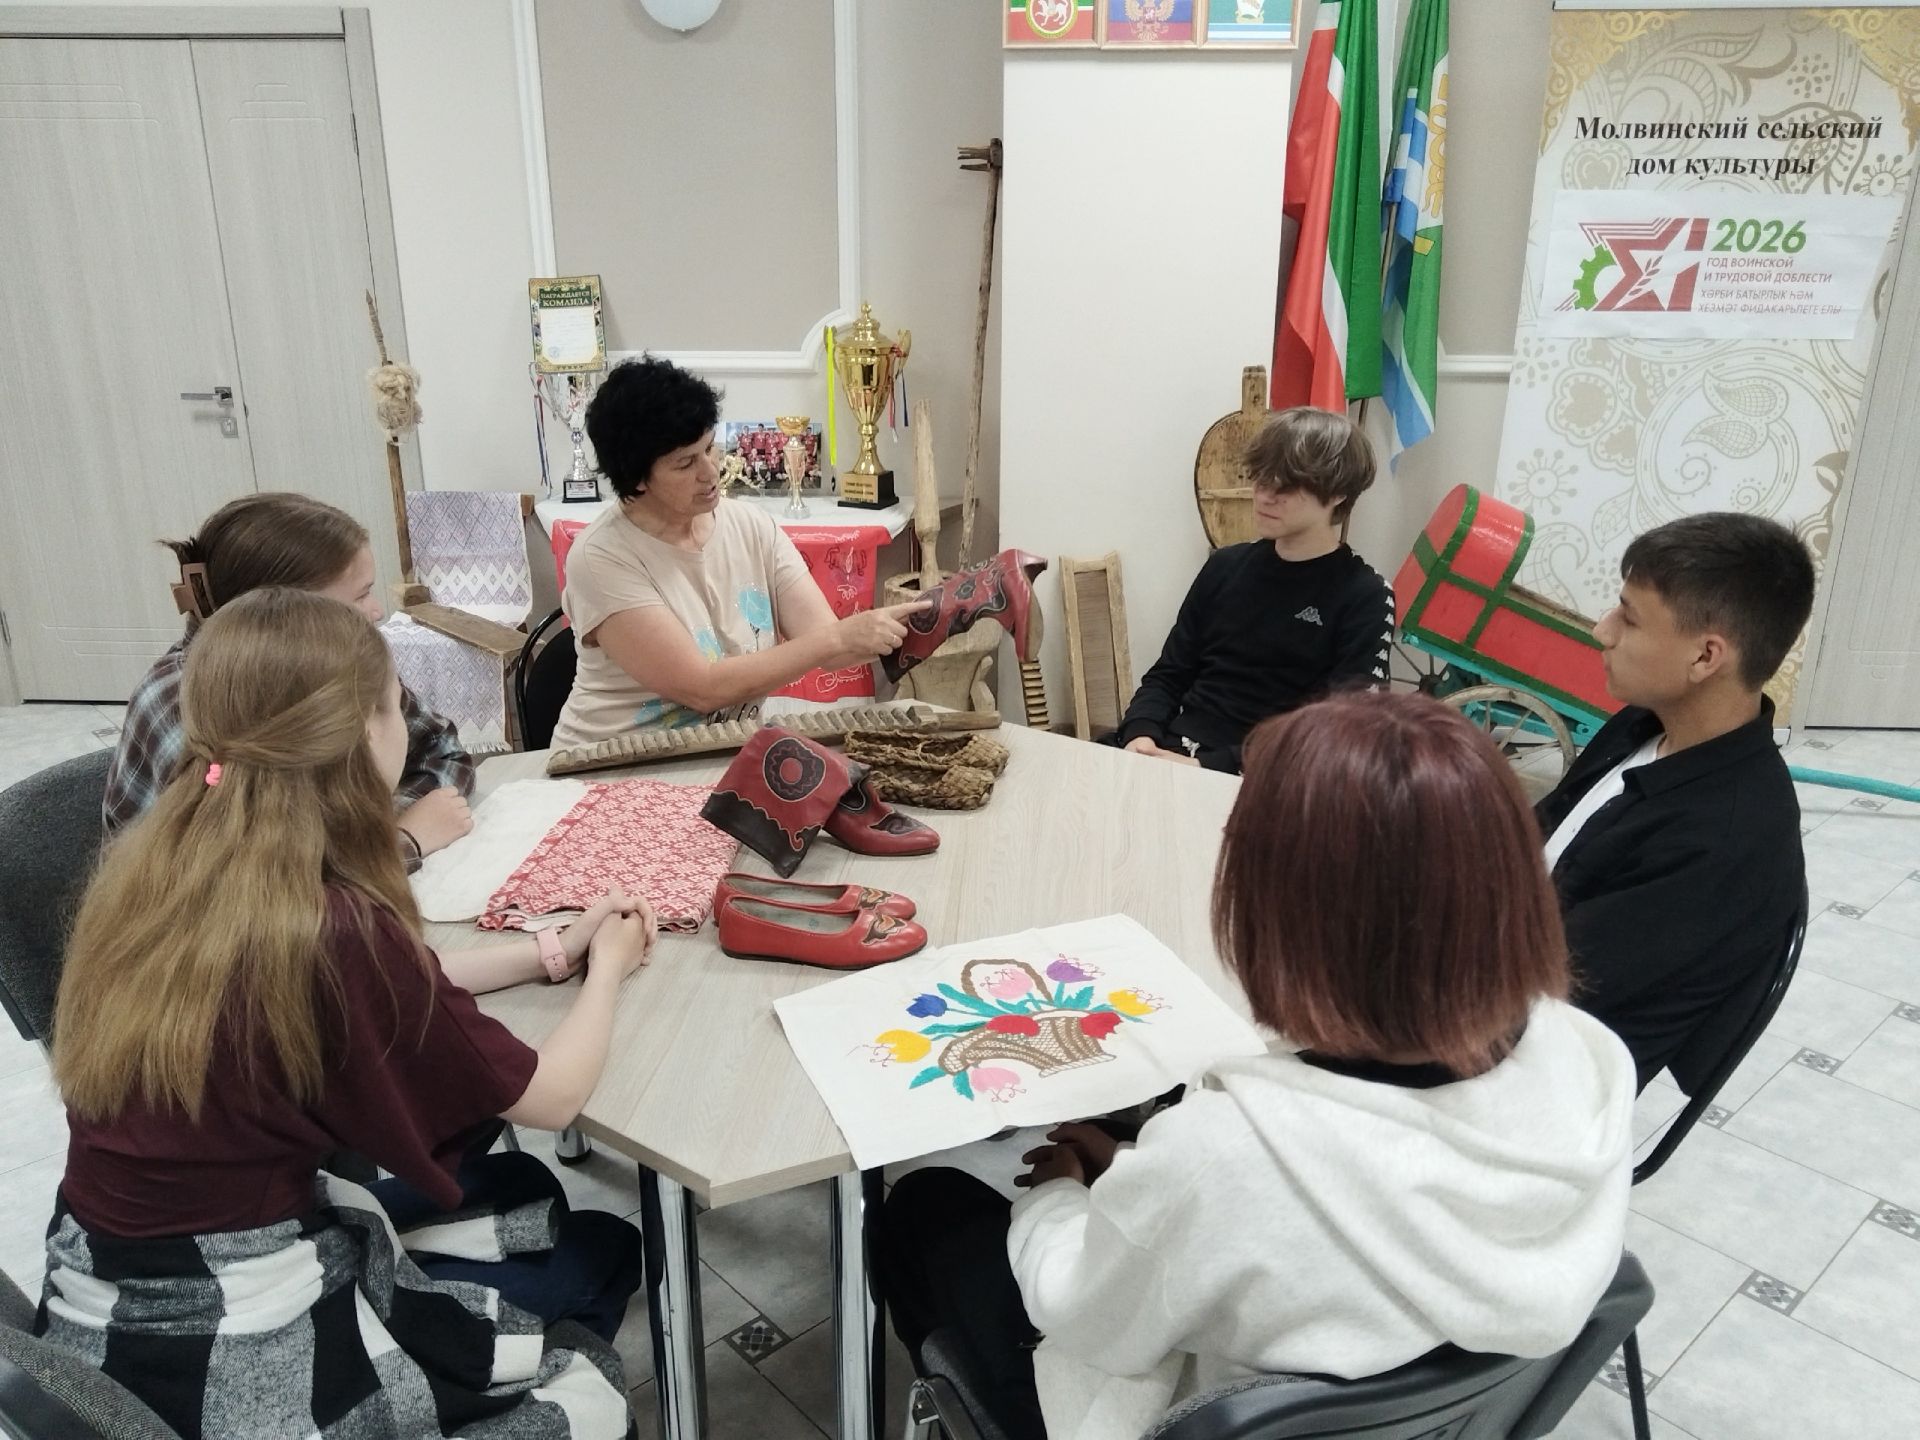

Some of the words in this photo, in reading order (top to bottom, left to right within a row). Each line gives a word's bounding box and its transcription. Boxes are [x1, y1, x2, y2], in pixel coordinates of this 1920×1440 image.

[1575, 116, 1748, 140] Молвинский
[1756, 117, 1883, 140] сельский
[1626, 158, 1676, 176] дом
[1685, 157, 1816, 180] культуры
[1711, 218, 1806, 253] 2026
[1707, 257, 1728, 269] ГОД
[1730, 256, 1793, 268] ВОИНСКОЙ
[1704, 272, 1712, 281] И
[1715, 270, 1772, 284] ТРУДОВОЙ
[1774, 272, 1832, 284] ДОБЛЕСТИ
[1736, 289, 1788, 300] БАТЫРЛЫК
[543, 298, 589, 307] КОМАНДА
